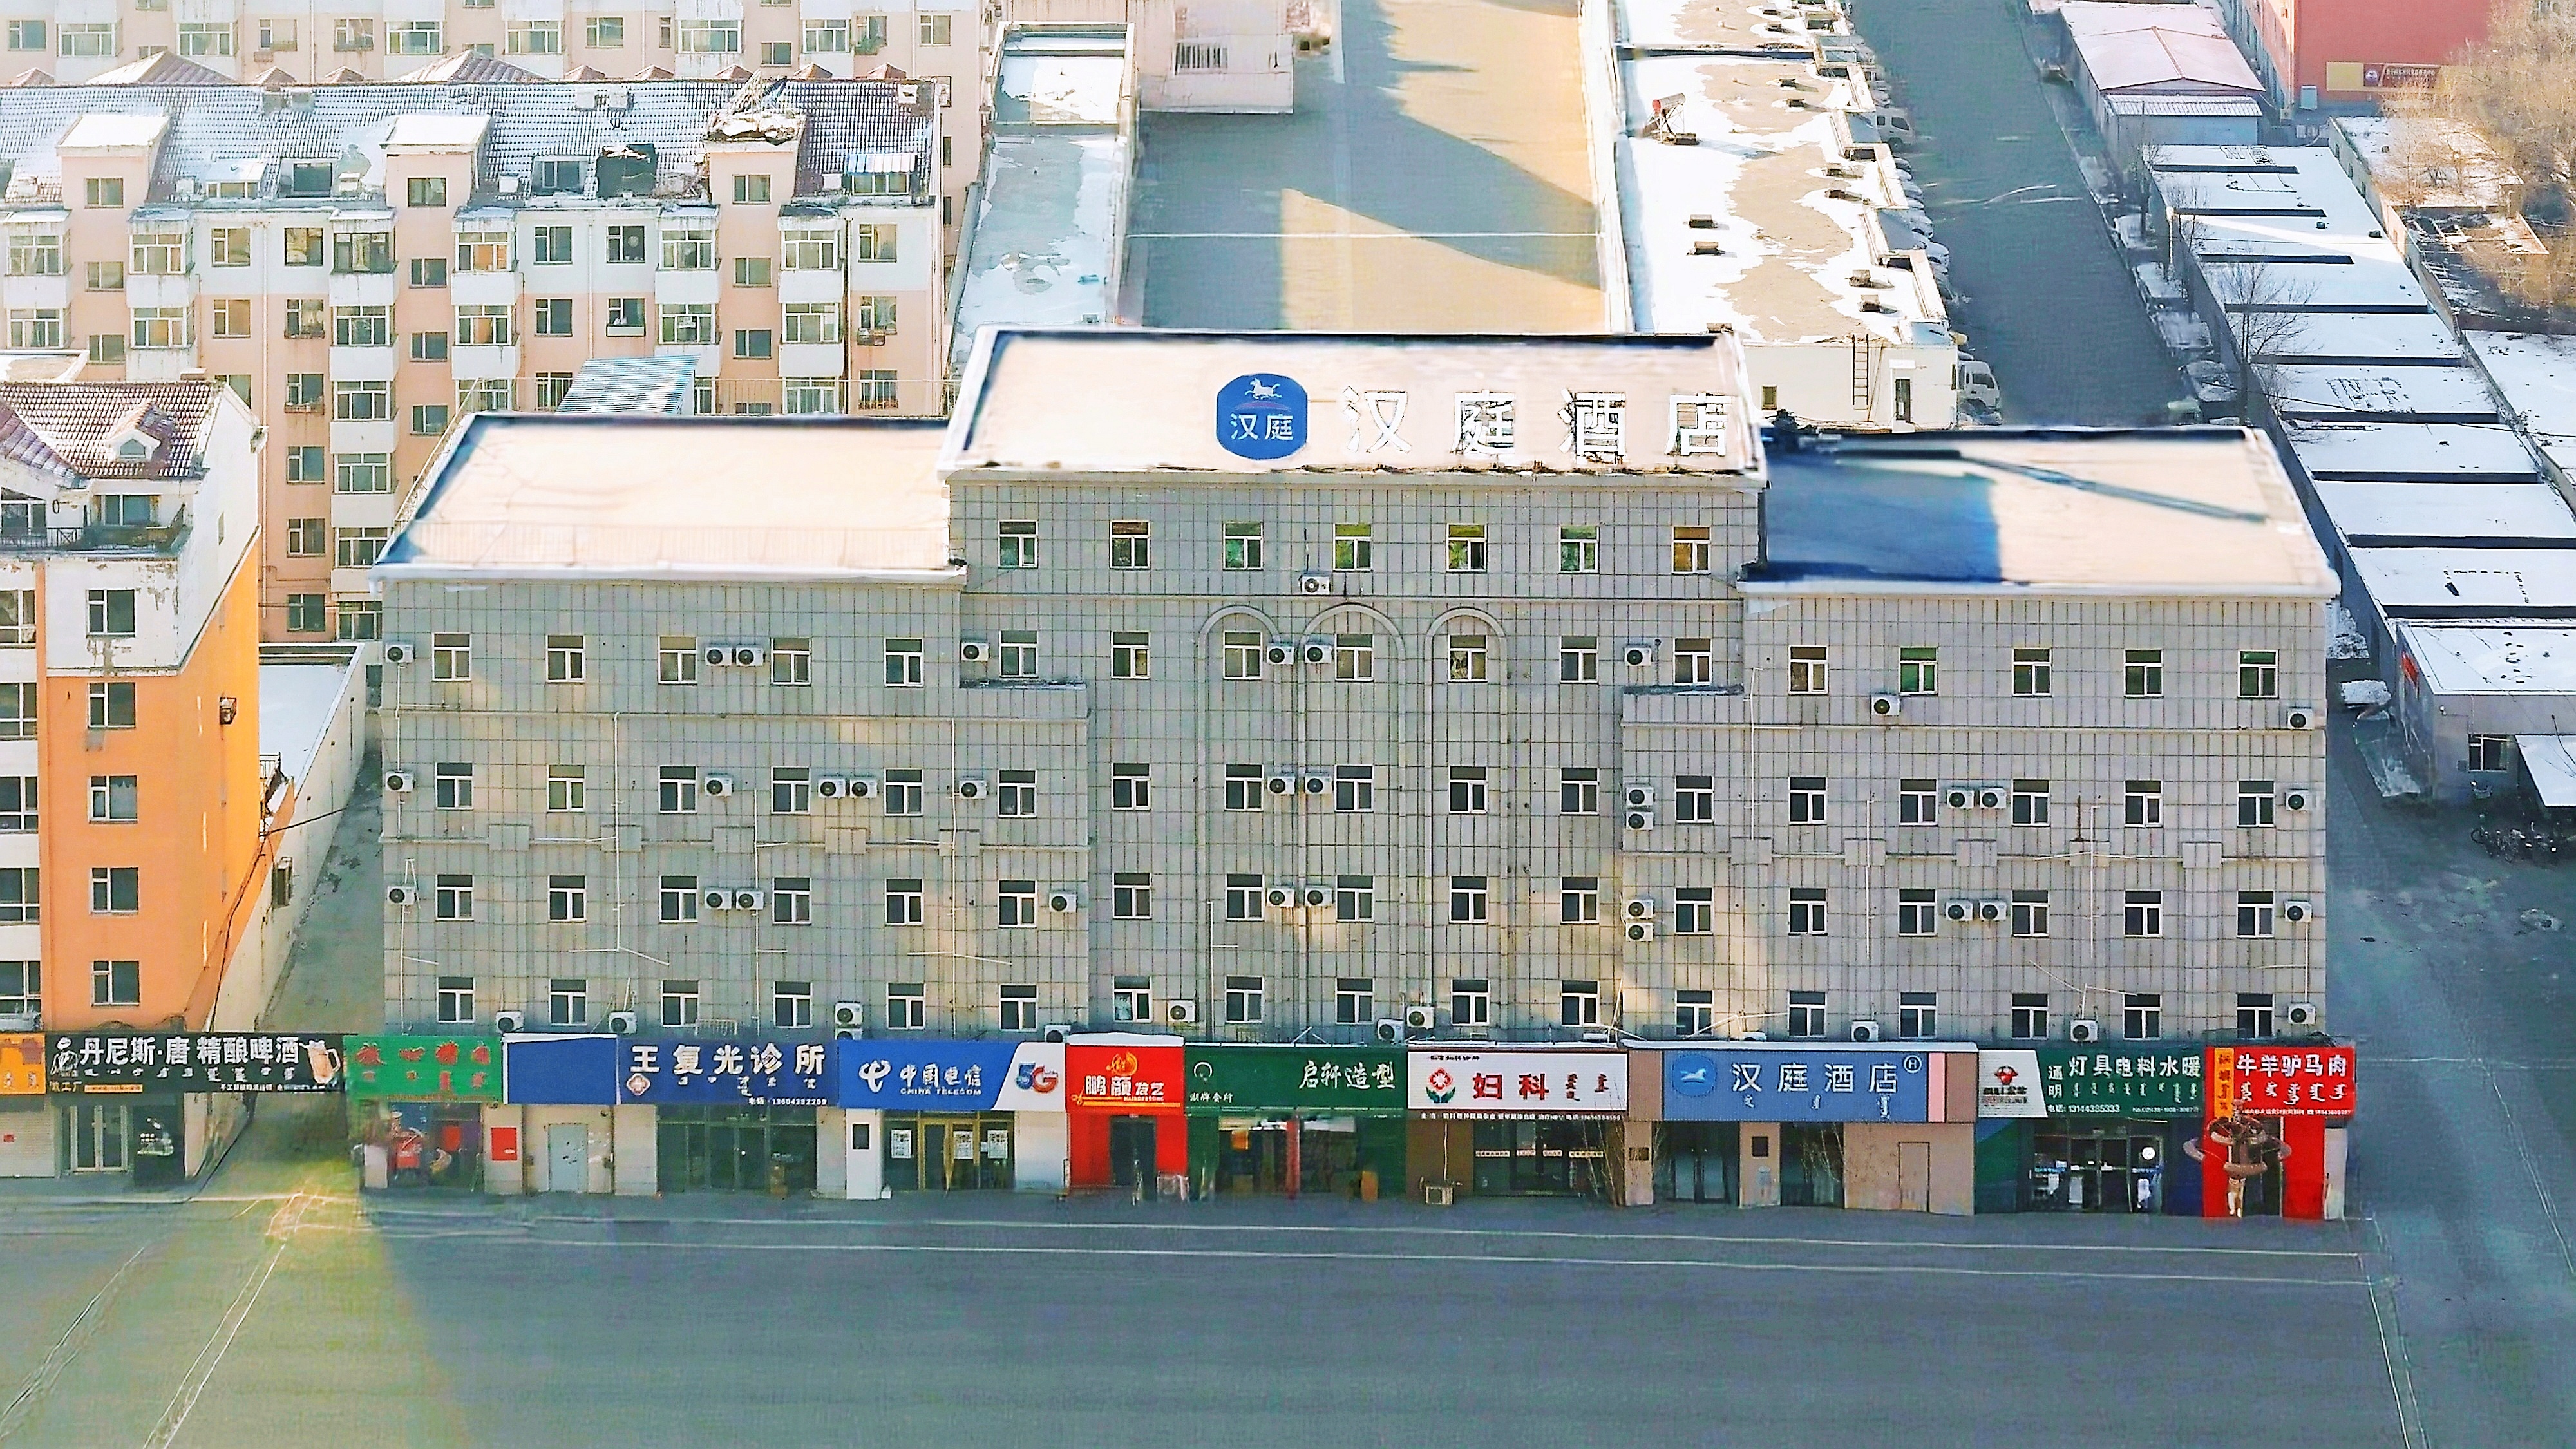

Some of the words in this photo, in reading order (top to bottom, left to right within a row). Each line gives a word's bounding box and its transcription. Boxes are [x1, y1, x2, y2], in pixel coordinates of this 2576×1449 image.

[1231, 413, 1293, 440] 汉庭
[1343, 386, 1732, 457] 汉庭酒店
[197, 1036, 299, 1066] 精酿啤酒
[630, 1043, 826, 1075] 王复光诊所
[900, 1063, 982, 1088] 中国电信
[1015, 1063, 1059, 1093] 5G
[1298, 1060, 1396, 1089] 启轩造型
[1731, 1062, 1899, 1094] 汉庭酒店
[2069, 1054, 2201, 1078] 灯具电料水暖
[2236, 1054, 2347, 1078] 牛羊驴马肉
[936, 1086, 981, 1095] TELECOM
[1473, 1073, 1549, 1100] 妇科
[2047, 1065, 2063, 1099] 通明
